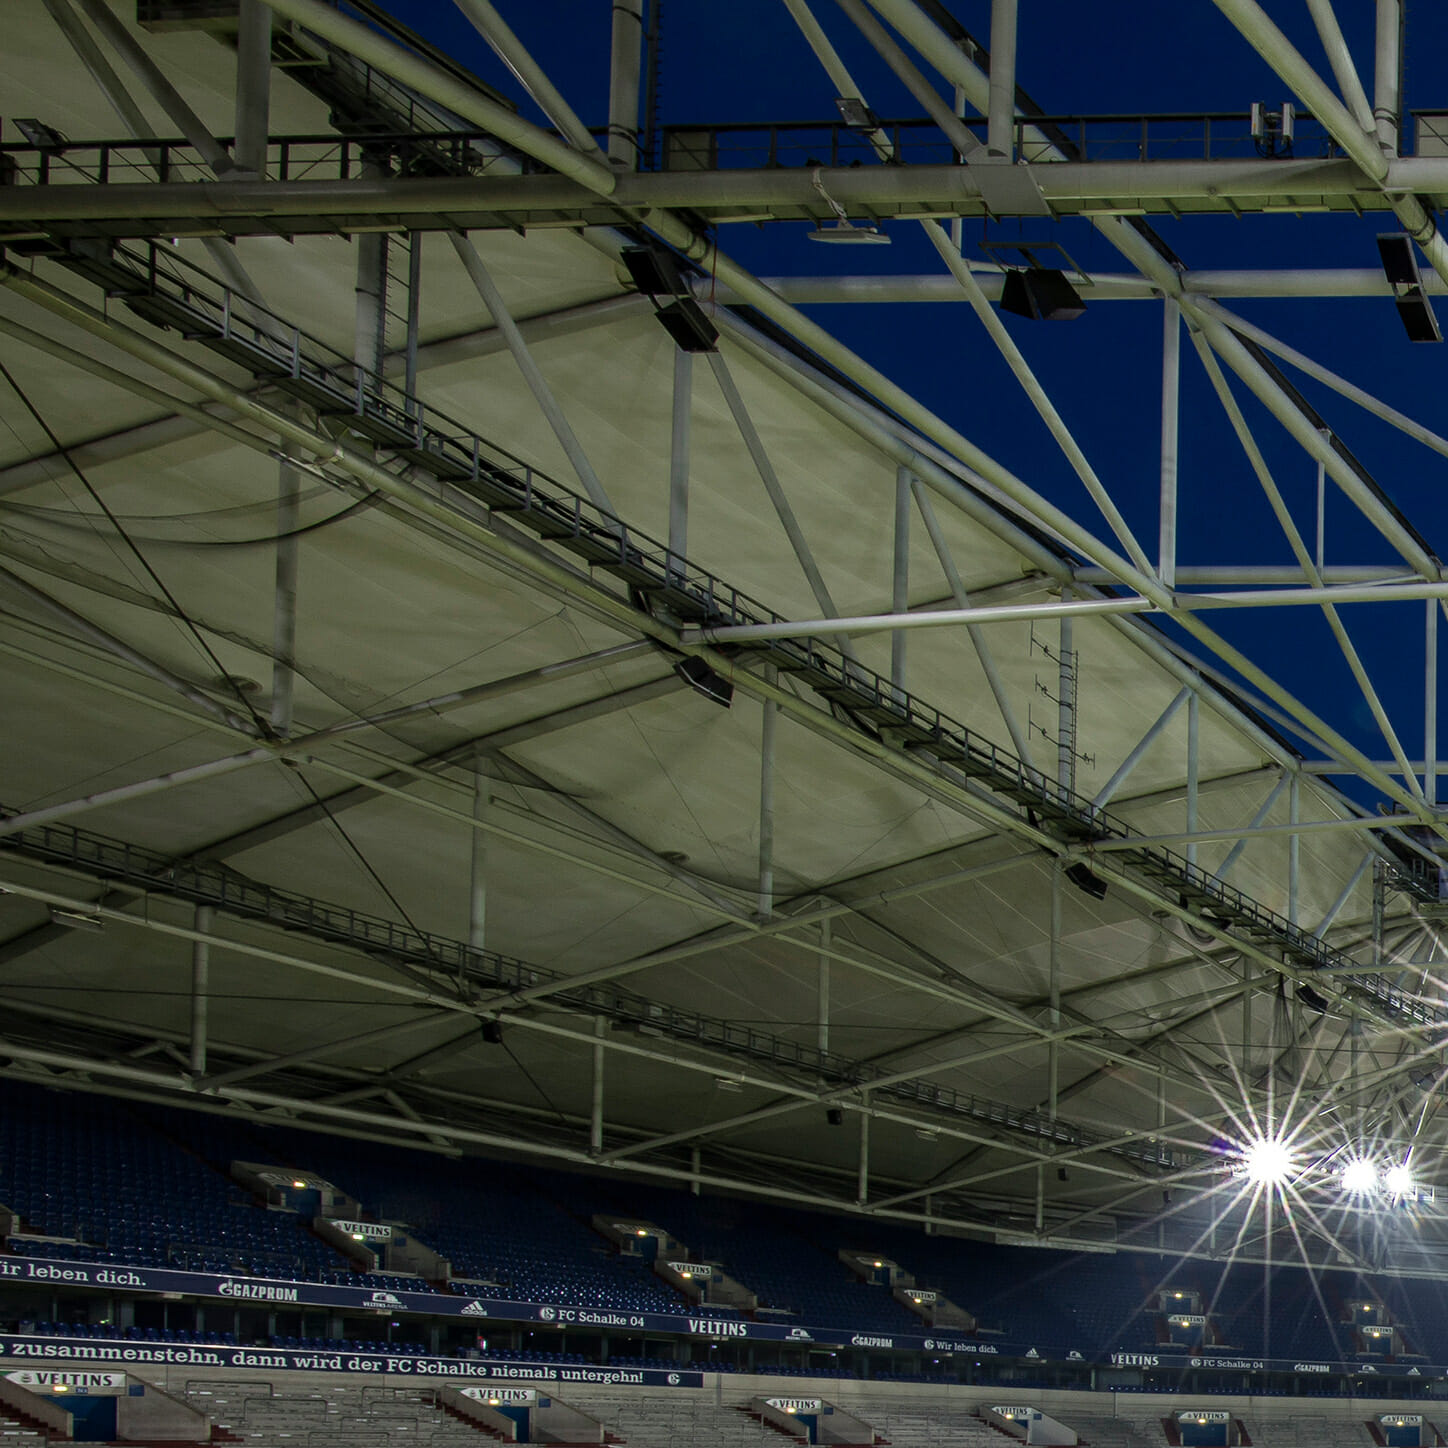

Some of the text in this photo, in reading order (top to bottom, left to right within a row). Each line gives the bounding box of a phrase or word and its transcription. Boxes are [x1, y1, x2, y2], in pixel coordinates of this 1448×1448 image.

[344, 1223, 390, 1237] VELTINS
[0, 1261, 147, 1287] ir leben dich.
[676, 1263, 711, 1275] VELTINS
[234, 1283, 298, 1302] GAZPROM
[909, 1291, 936, 1300] VELTINS
[558, 1310, 645, 1327] FC Schalke 04
[689, 1320, 747, 1337] VELTINS
[860, 1336, 893, 1348] GAZPROM
[936, 1341, 999, 1354] Wir leben dich.
[12, 1344, 225, 1367] zusammenstehn,
[232, 1351, 288, 1368] dann
[293, 1356, 342, 1371] wird
[347, 1357, 382, 1372] der
[387, 1360, 412, 1373] FC
[416, 1360, 487, 1376] Schalke
[491, 1364, 557, 1380] niemals
[561, 1369, 644, 1385] untergehn!
[1111, 1354, 1159, 1366] VELTINS
[1204, 1359, 1264, 1370] FC Schalke 04
[1301, 1364, 1330, 1373] GAZPROM
[37, 1373, 113, 1388] VELTINS
[479, 1389, 528, 1400] VELTINS
[779, 1399, 816, 1410] VELTINS
[1001, 1407, 1028, 1415] VELTINS
[1193, 1412, 1225, 1420] VELTINS
